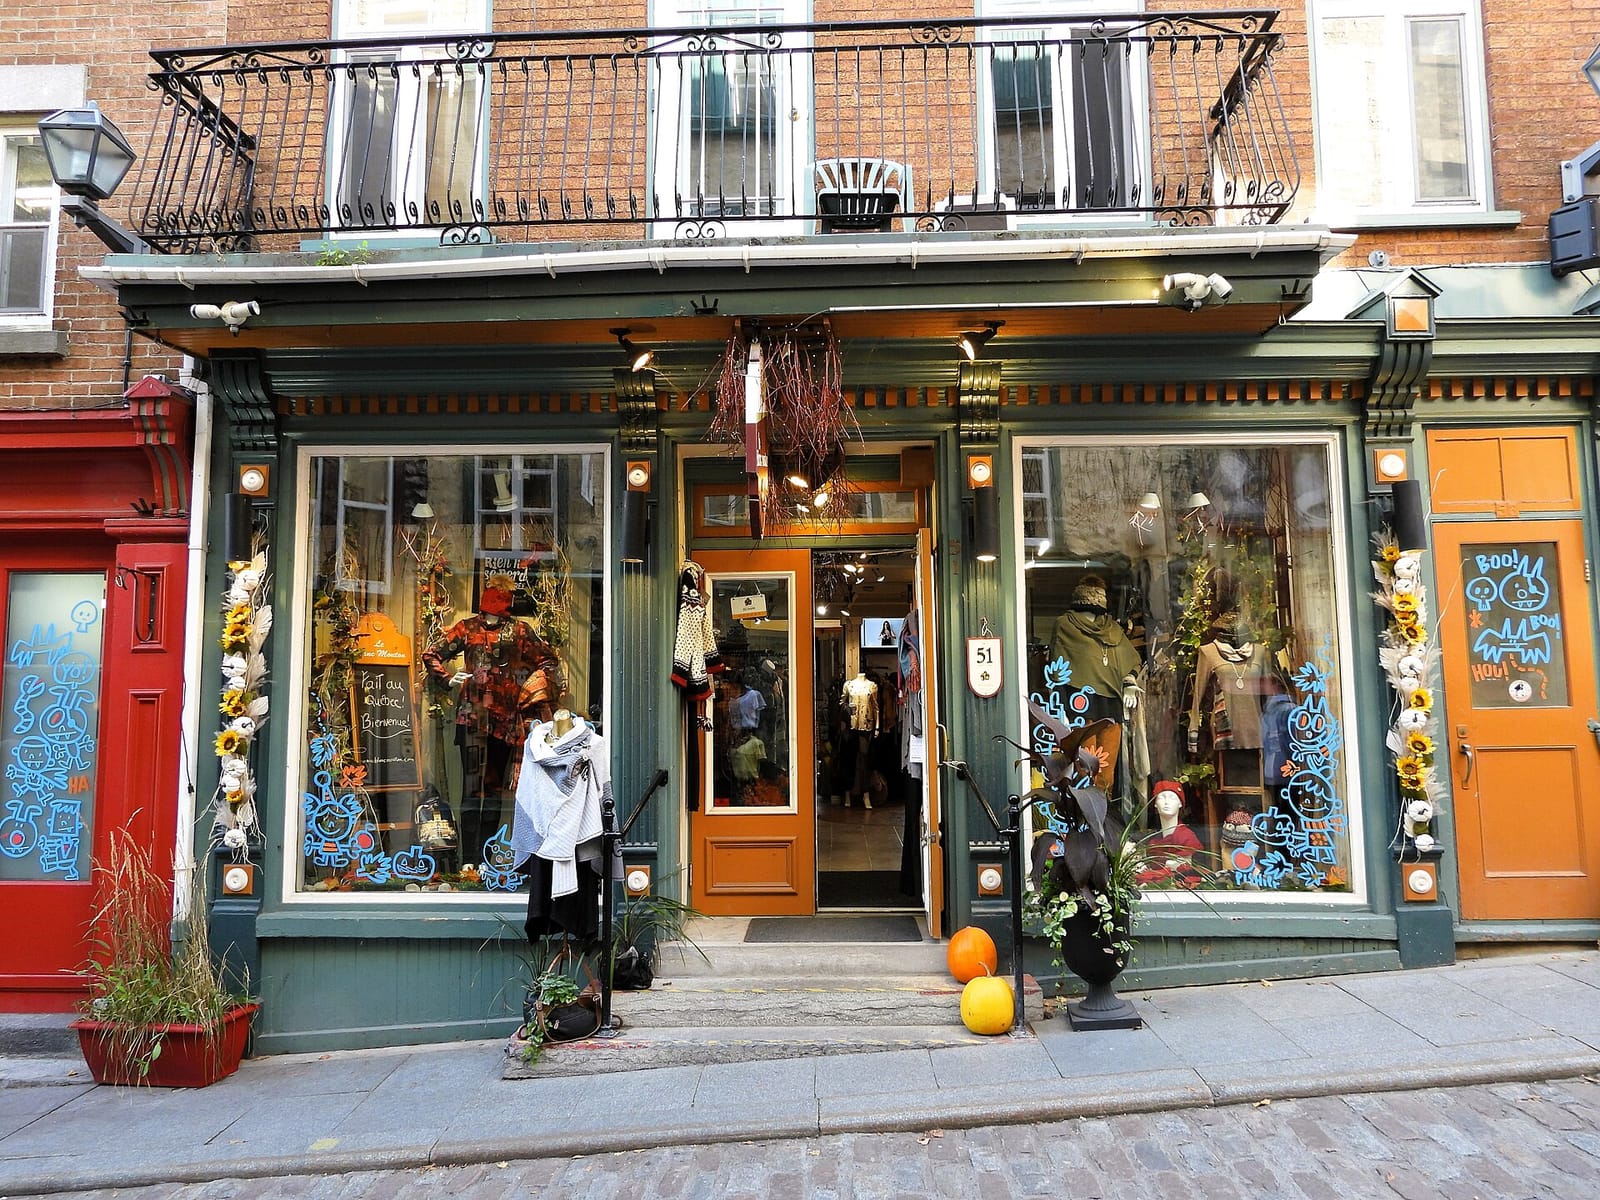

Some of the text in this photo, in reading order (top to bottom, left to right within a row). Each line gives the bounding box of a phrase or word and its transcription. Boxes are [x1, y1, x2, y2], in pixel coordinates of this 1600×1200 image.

[1475, 548, 1519, 575] BOO!
[1529, 613, 1561, 640] BOO!
[374, 639, 385, 648] Le
[377, 649, 406, 658] Mouton
[976, 647, 993, 664] 51
[386, 680, 404, 692] au
[361, 712, 410, 729] Bienvenue!
[68, 775, 89, 795] HA
